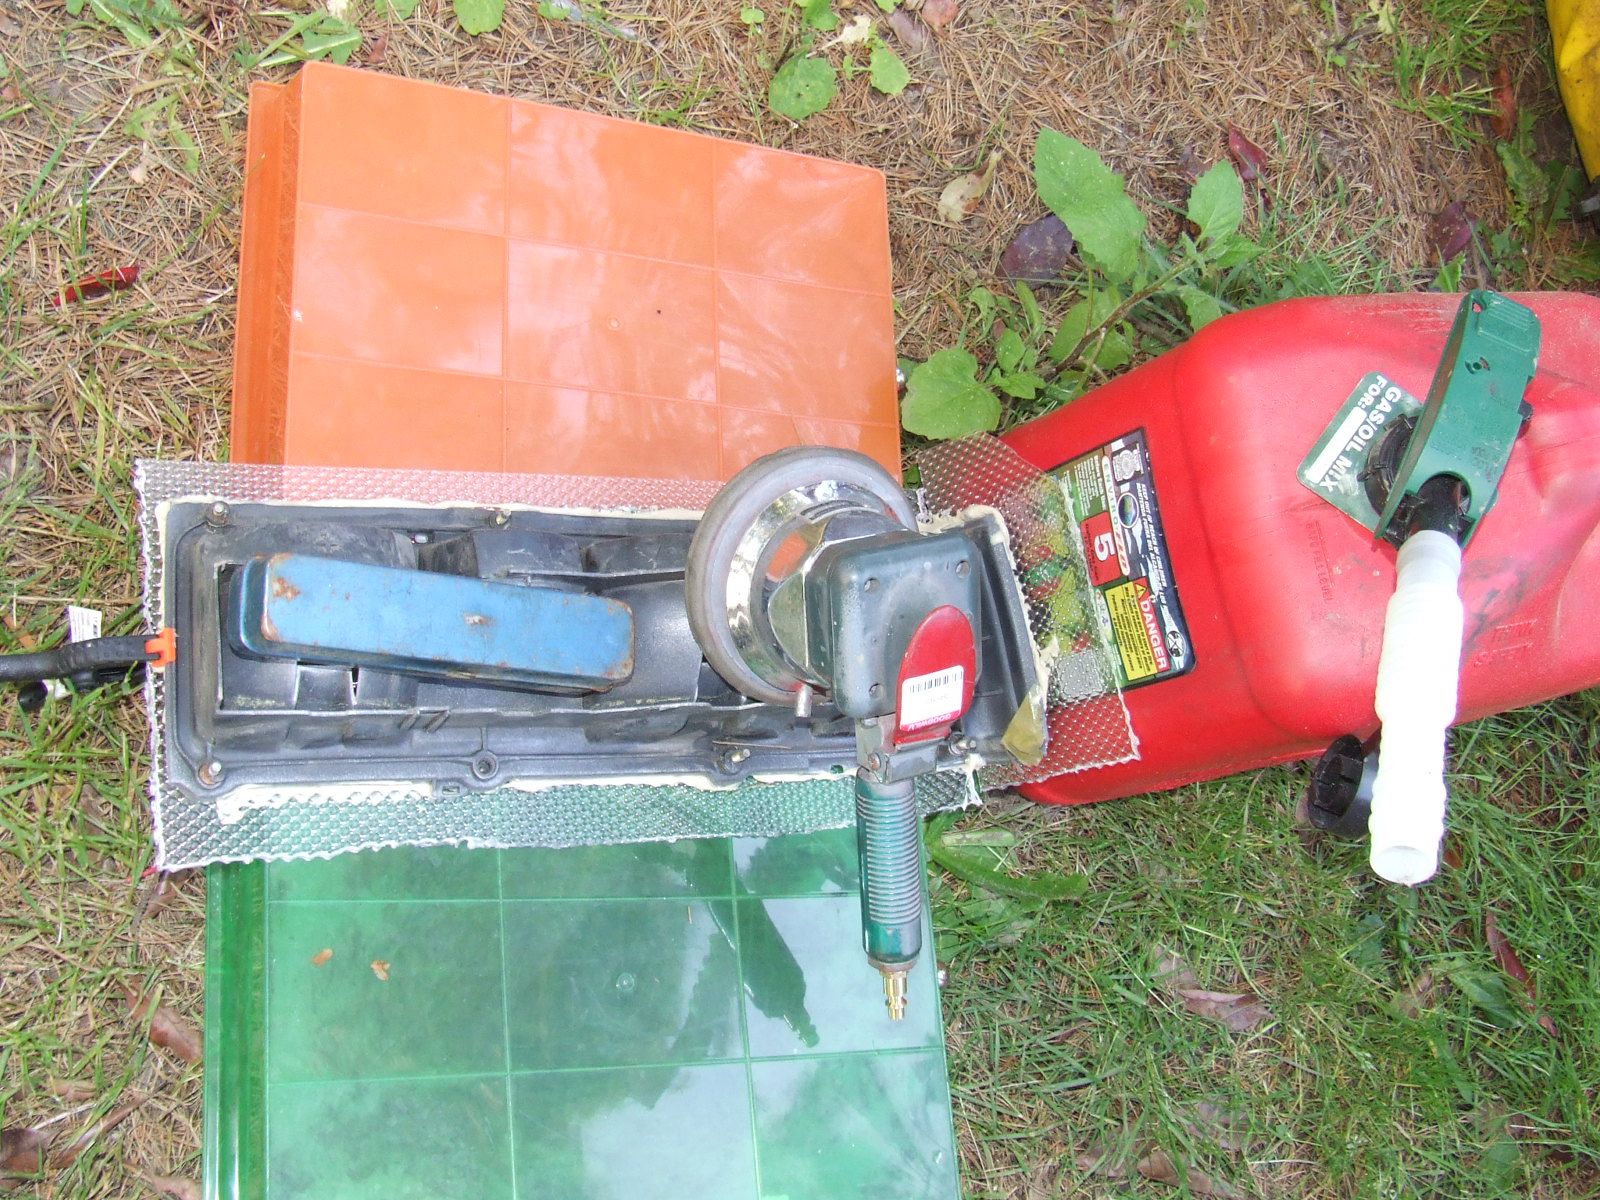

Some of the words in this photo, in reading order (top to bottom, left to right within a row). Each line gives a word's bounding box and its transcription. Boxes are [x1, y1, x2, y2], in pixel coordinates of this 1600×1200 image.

[1357, 375, 1388, 409] FOR:
[1345, 386, 1402, 452] GAS/OIL
[1319, 455, 1352, 492] MIX
[1091, 531, 1117, 562] 5
[1139, 598, 1167, 669] DANGER
